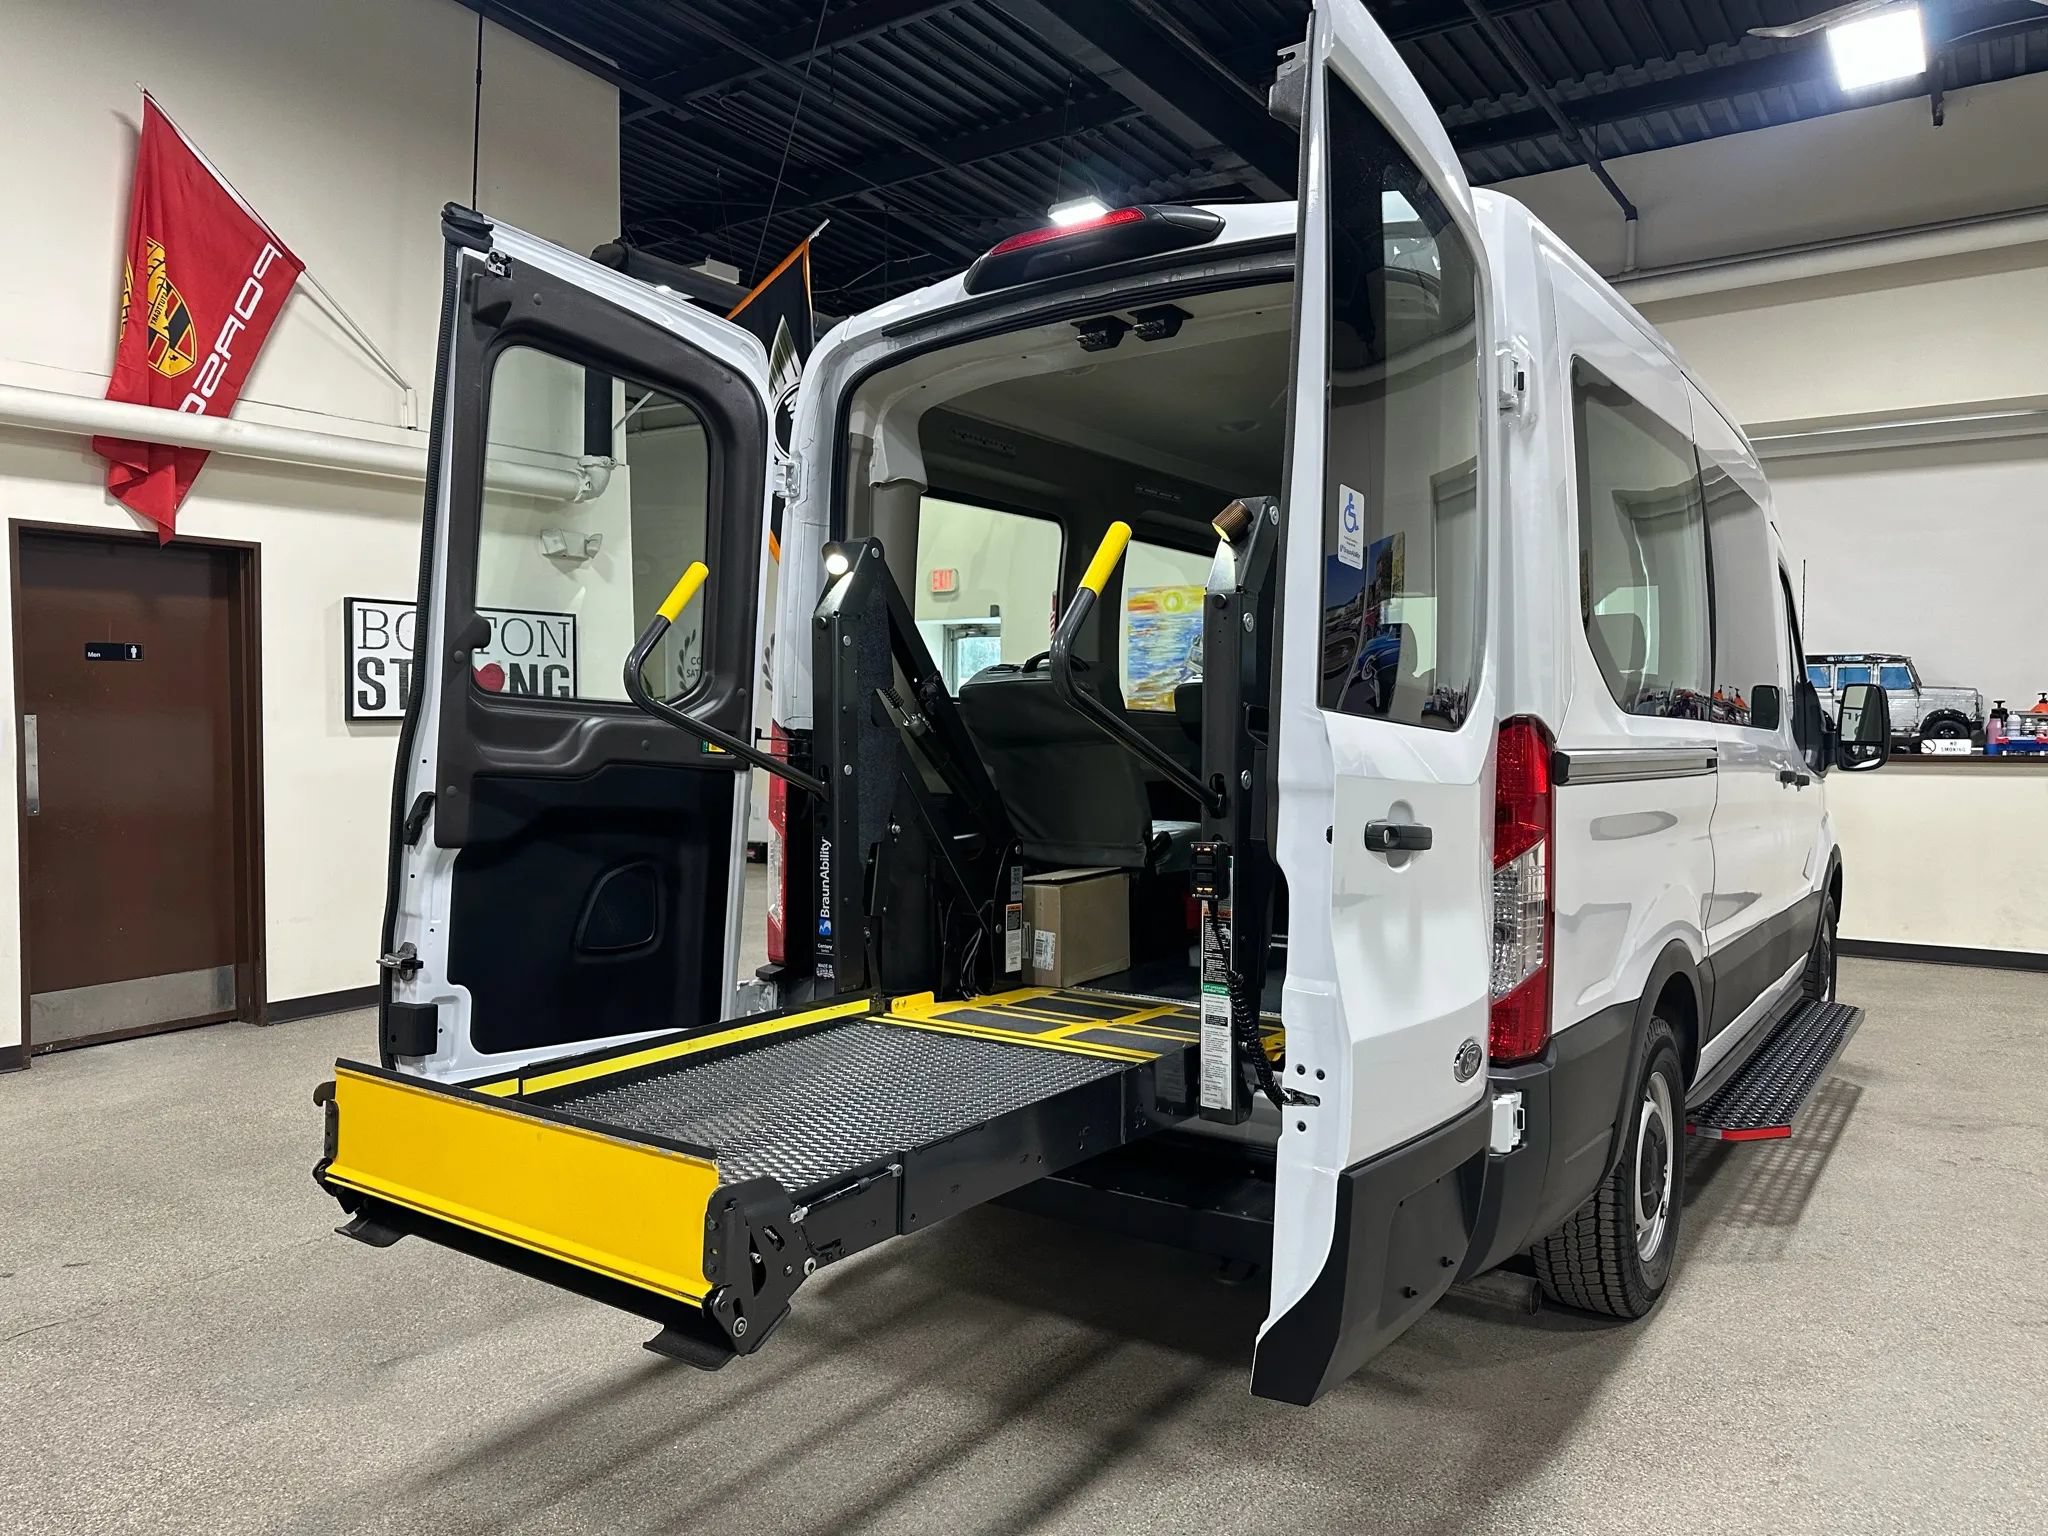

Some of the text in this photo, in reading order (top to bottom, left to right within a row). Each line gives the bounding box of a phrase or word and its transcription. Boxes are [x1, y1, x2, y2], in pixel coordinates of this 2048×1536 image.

[932, 570, 953, 590] EXIT
[357, 608, 570, 658] BOON
[819, 838, 832, 918] BraunAbility
